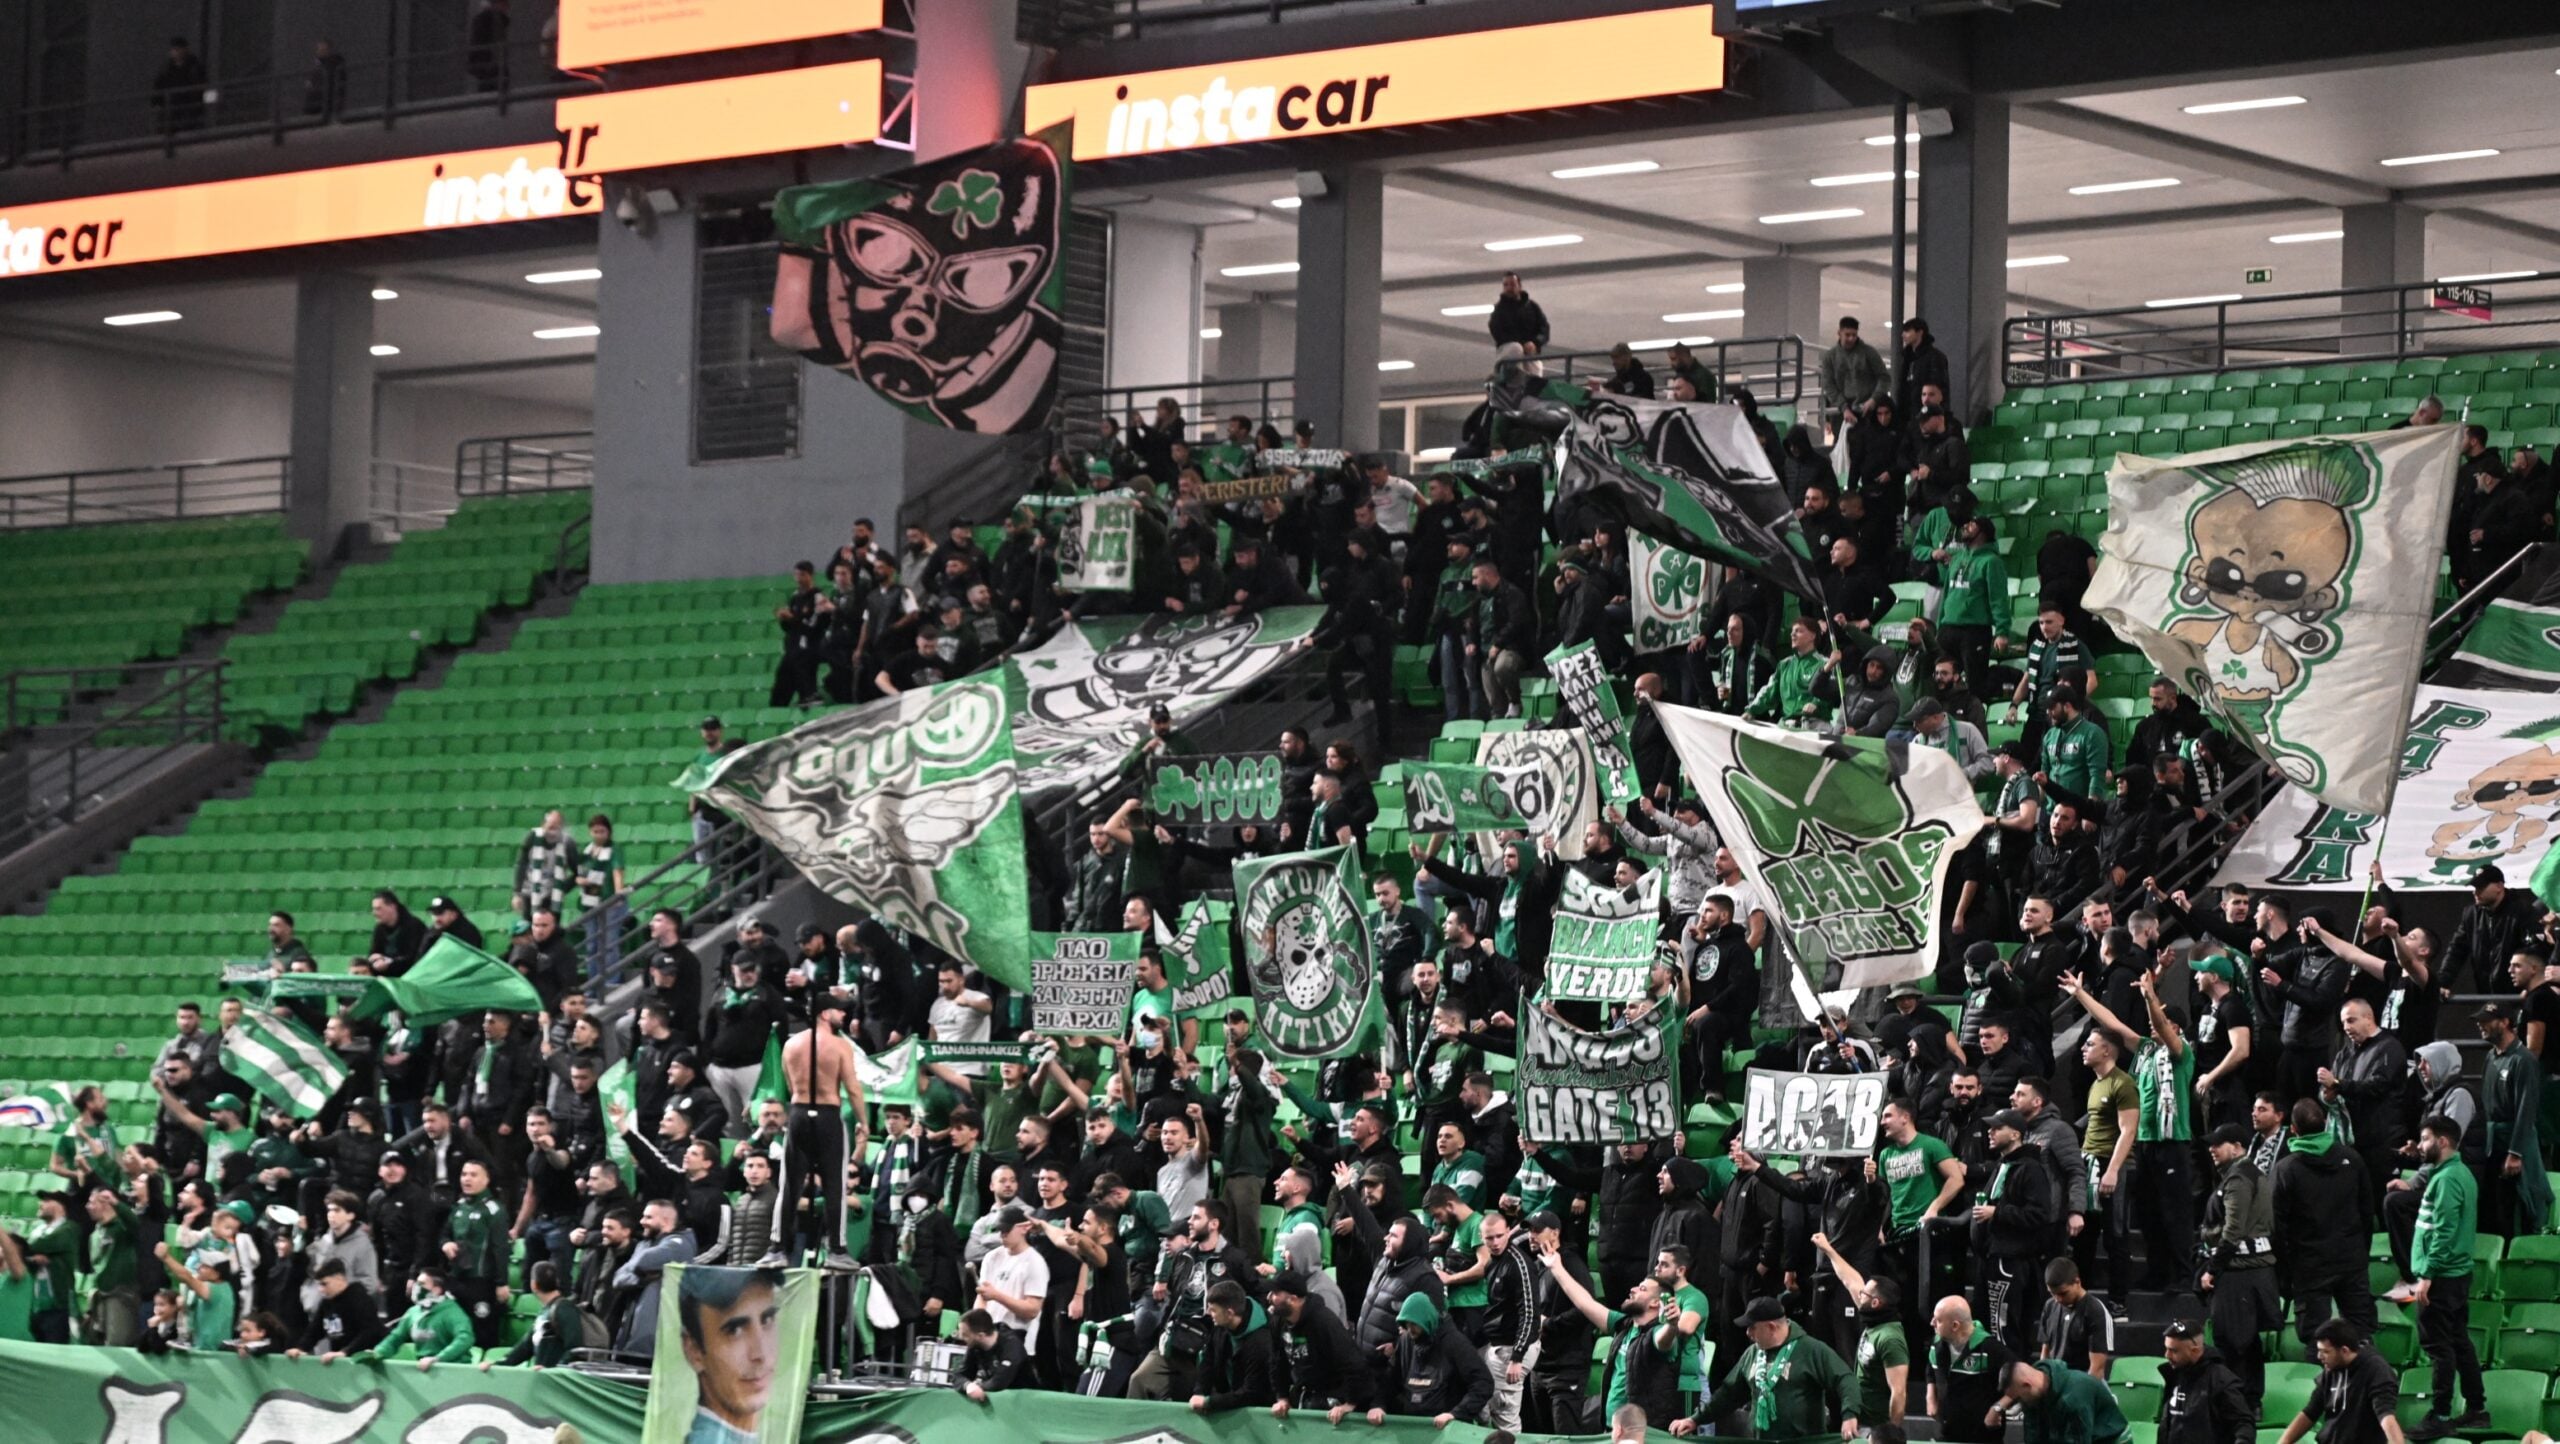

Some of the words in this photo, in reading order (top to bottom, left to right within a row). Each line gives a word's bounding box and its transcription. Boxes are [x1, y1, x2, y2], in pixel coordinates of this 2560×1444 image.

[1106, 75, 1391, 154] instacar
[1196, 755, 1283, 823] 1908
[1055, 937, 1110, 960] ΠΑΟ
[1820, 914, 1913, 956] GATE
[1067, 987, 1130, 1005] ΣΤΗΝ
[1548, 962, 1651, 999] VERDE
[1033, 1009, 1121, 1029] ΕΠΑΡΧΙΑ
[1525, 1087, 1624, 1143] GATE
[1627, 1081, 1677, 1139] 13
[1744, 1074, 1884, 1150] ACAB
